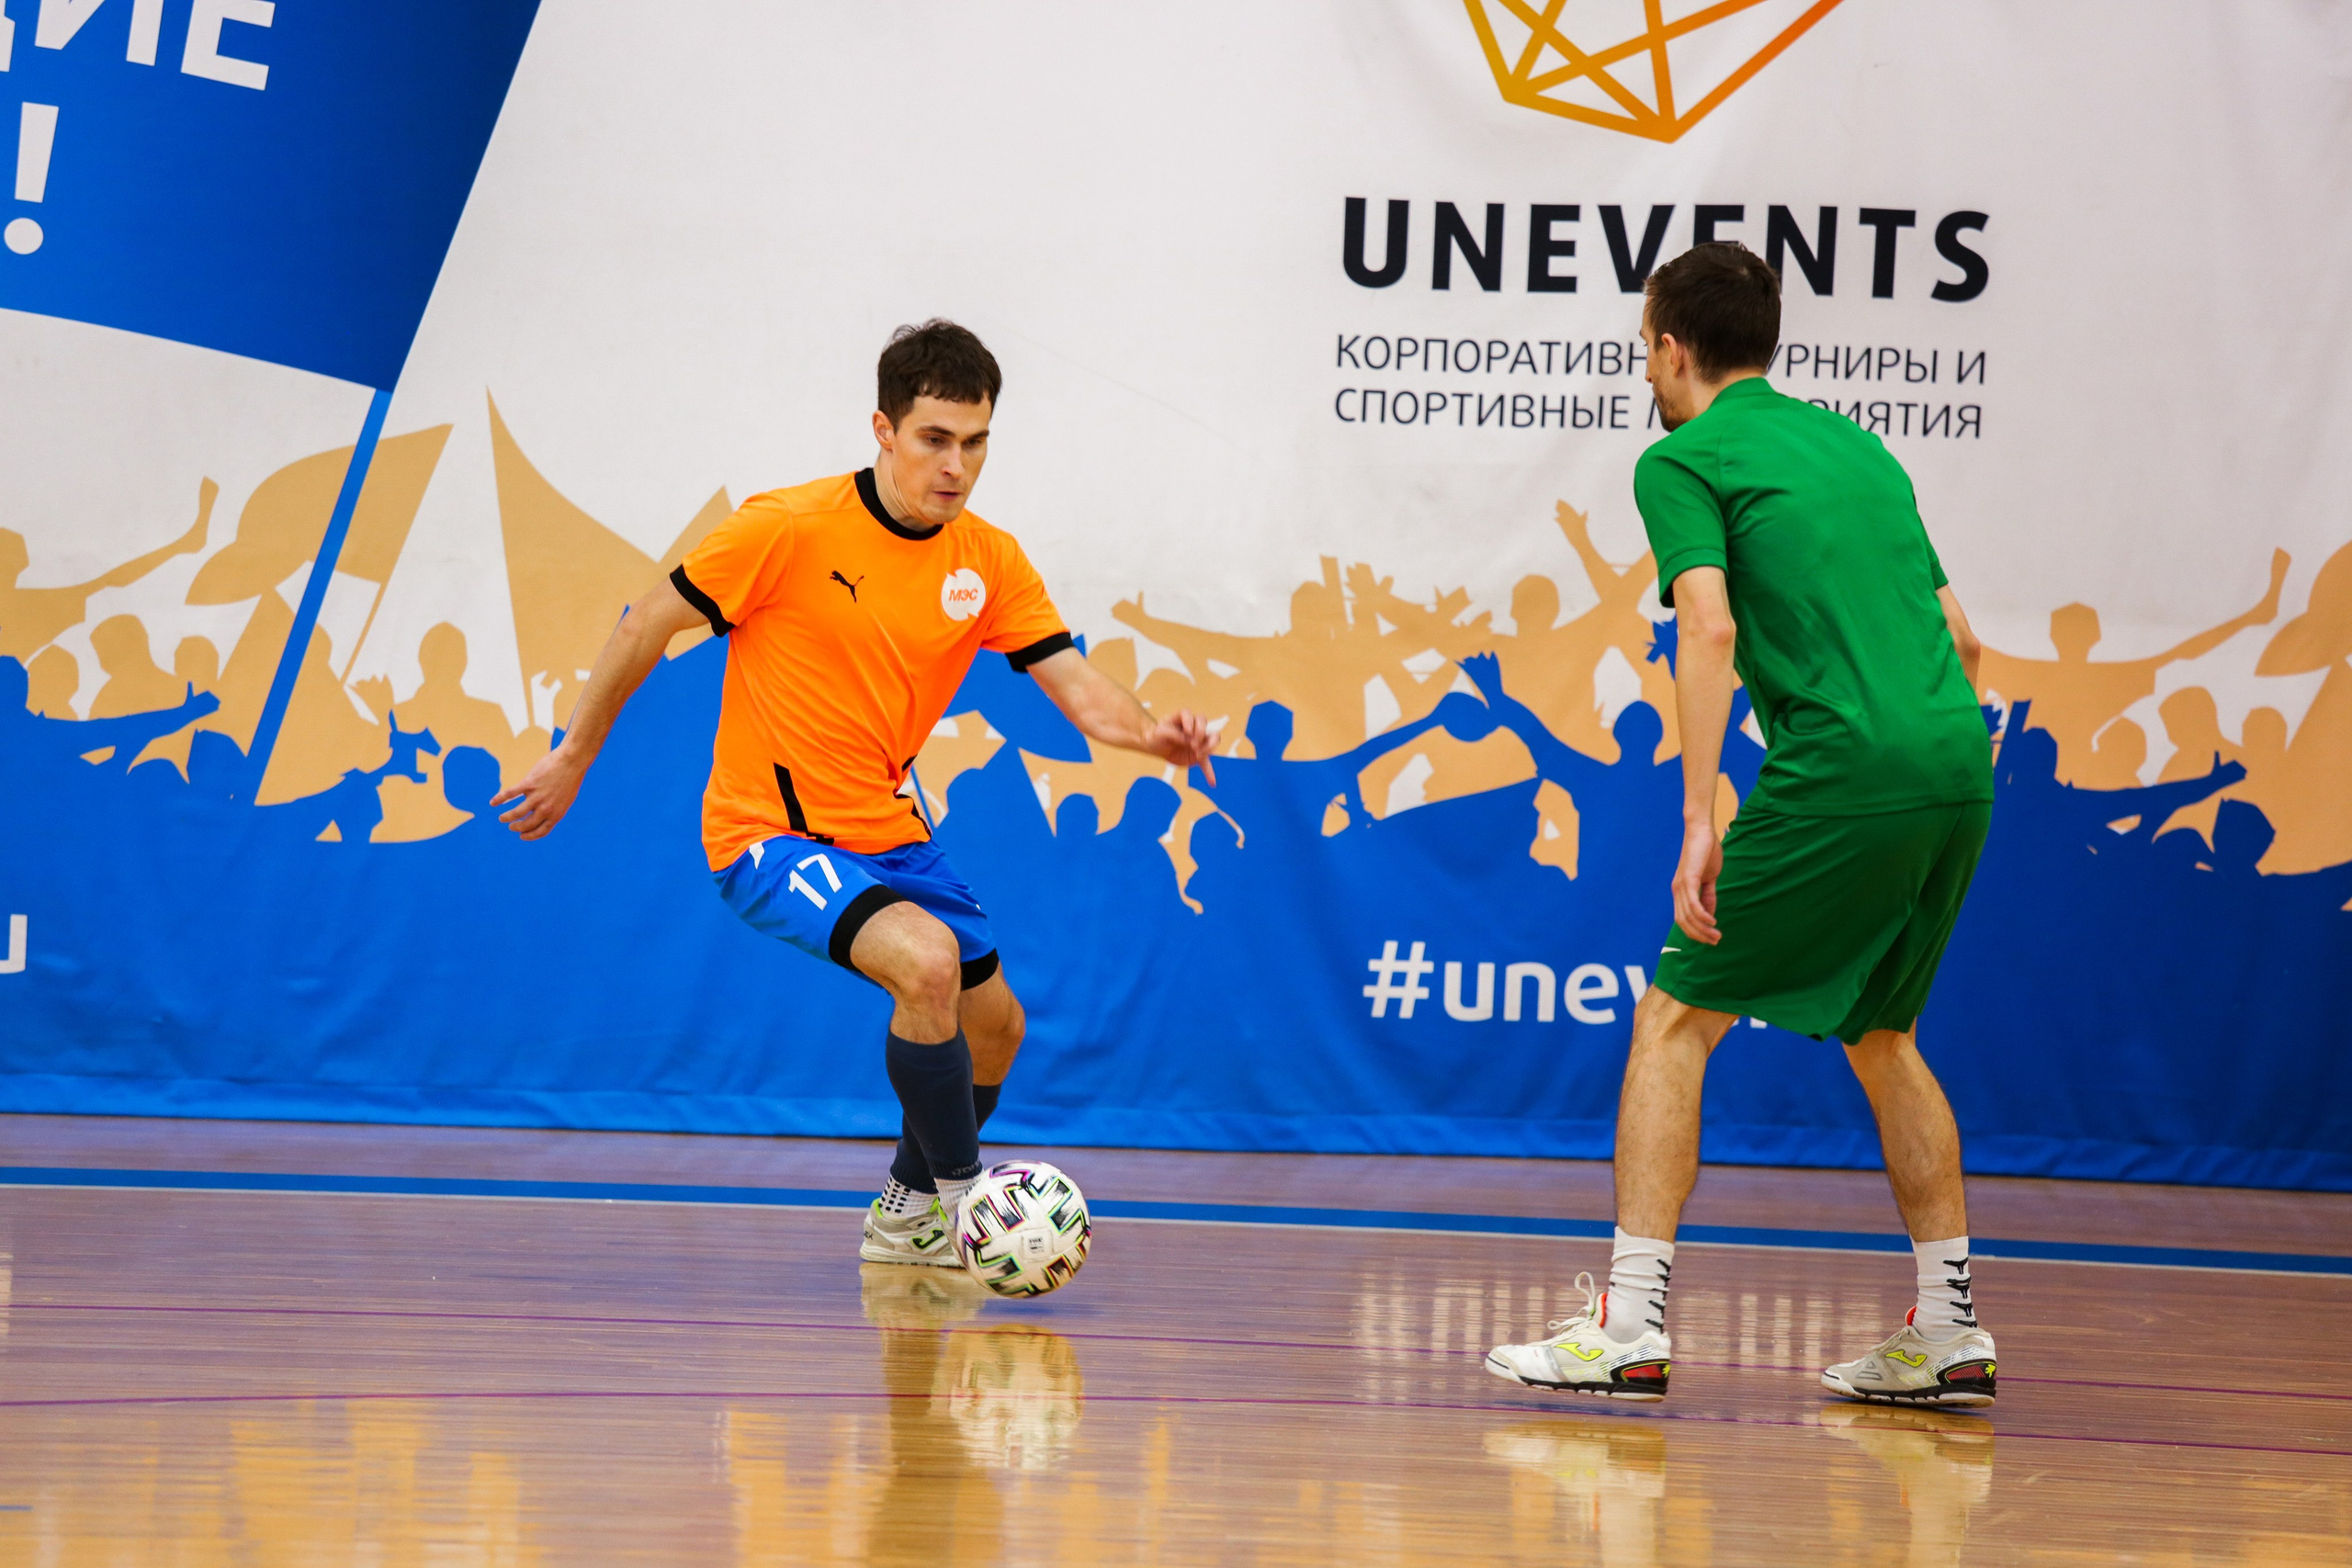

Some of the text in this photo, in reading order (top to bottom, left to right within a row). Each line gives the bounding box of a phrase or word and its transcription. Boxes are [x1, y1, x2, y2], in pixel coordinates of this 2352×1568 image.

[1337, 334, 1647, 376] КОРПОРАТИВН
[1956, 350, 1986, 386] И
[1335, 387, 1631, 430] СПОРТИВНЫЕ
[948, 588, 979, 603] МЭС
[788, 853, 843, 912] 17
